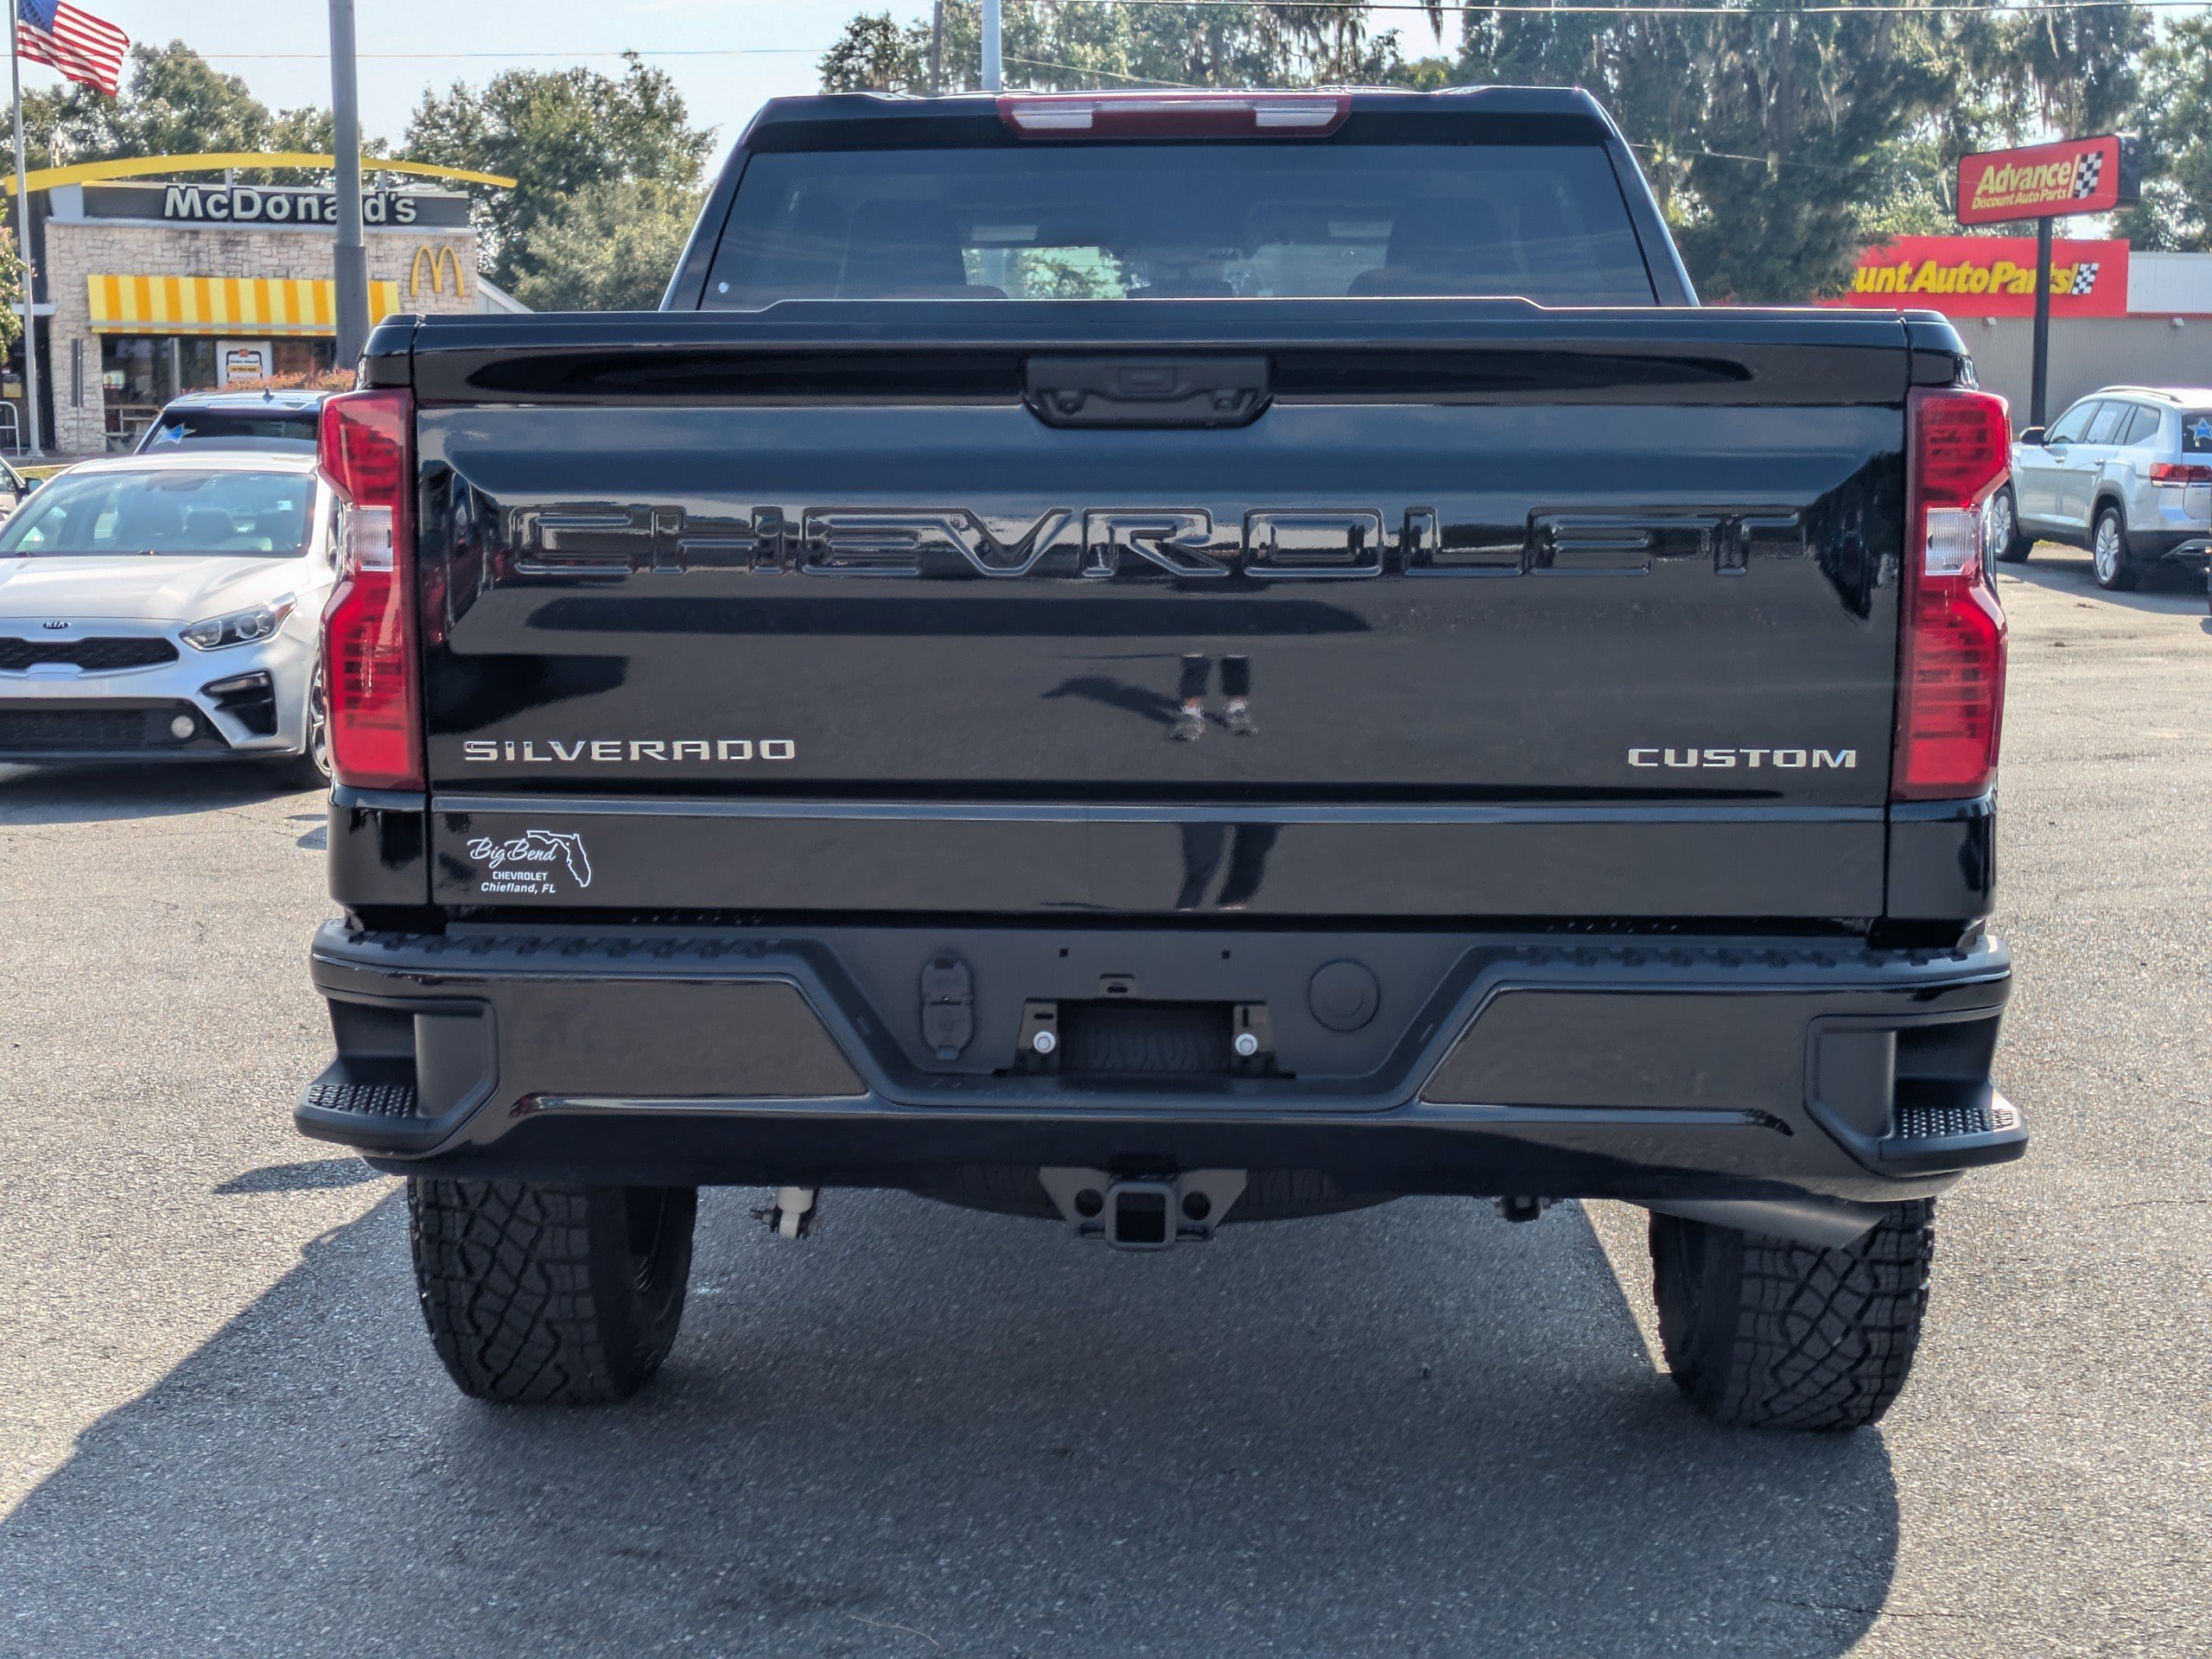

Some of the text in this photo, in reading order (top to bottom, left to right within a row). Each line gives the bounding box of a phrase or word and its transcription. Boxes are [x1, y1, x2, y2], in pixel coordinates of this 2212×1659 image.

[1975, 162, 2072, 195] Advance
[164, 187, 416, 223] McDonad's
[1972, 187, 2067, 210] Discount Auto Parts
[1910, 260, 1989, 294] Auto
[508, 504, 1802, 577] CHEVROLET
[463, 740, 796, 761] SILVERADO
[1628, 748, 1856, 767] CUSTOM
[467, 836, 559, 868] Big Bend
[480, 881, 556, 894] Chiefland, FL
[493, 871, 548, 881] CHEVROLET
